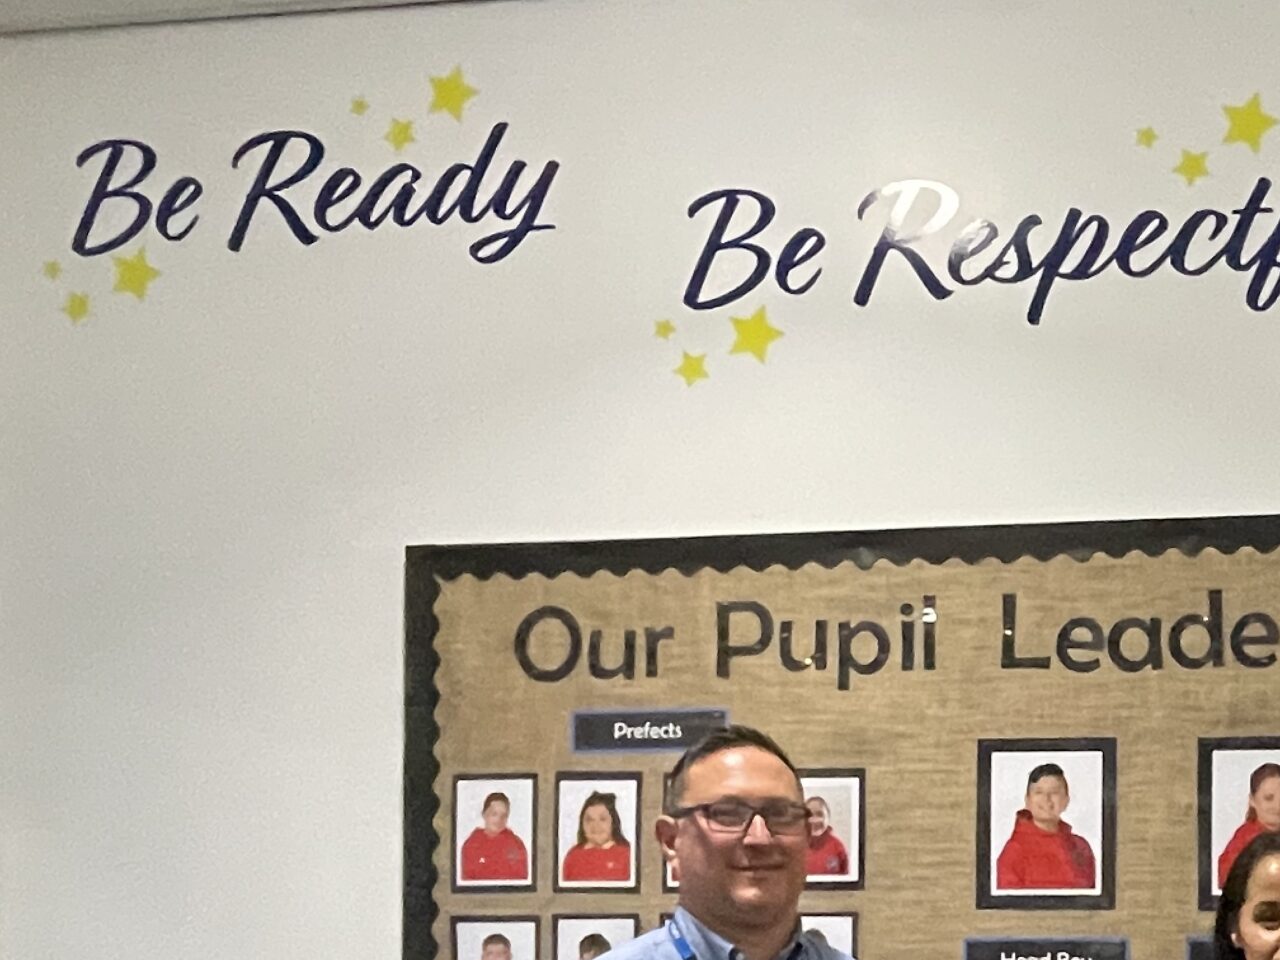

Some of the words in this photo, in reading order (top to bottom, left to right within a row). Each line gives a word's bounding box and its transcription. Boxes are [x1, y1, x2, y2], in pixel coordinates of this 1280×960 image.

[71, 138, 203, 257] Be
[227, 121, 560, 265] Ready
[682, 188, 826, 311] Be
[513, 604, 675, 683] Our
[714, 594, 937, 692] Pupil
[613, 721, 683, 740] Prefects
